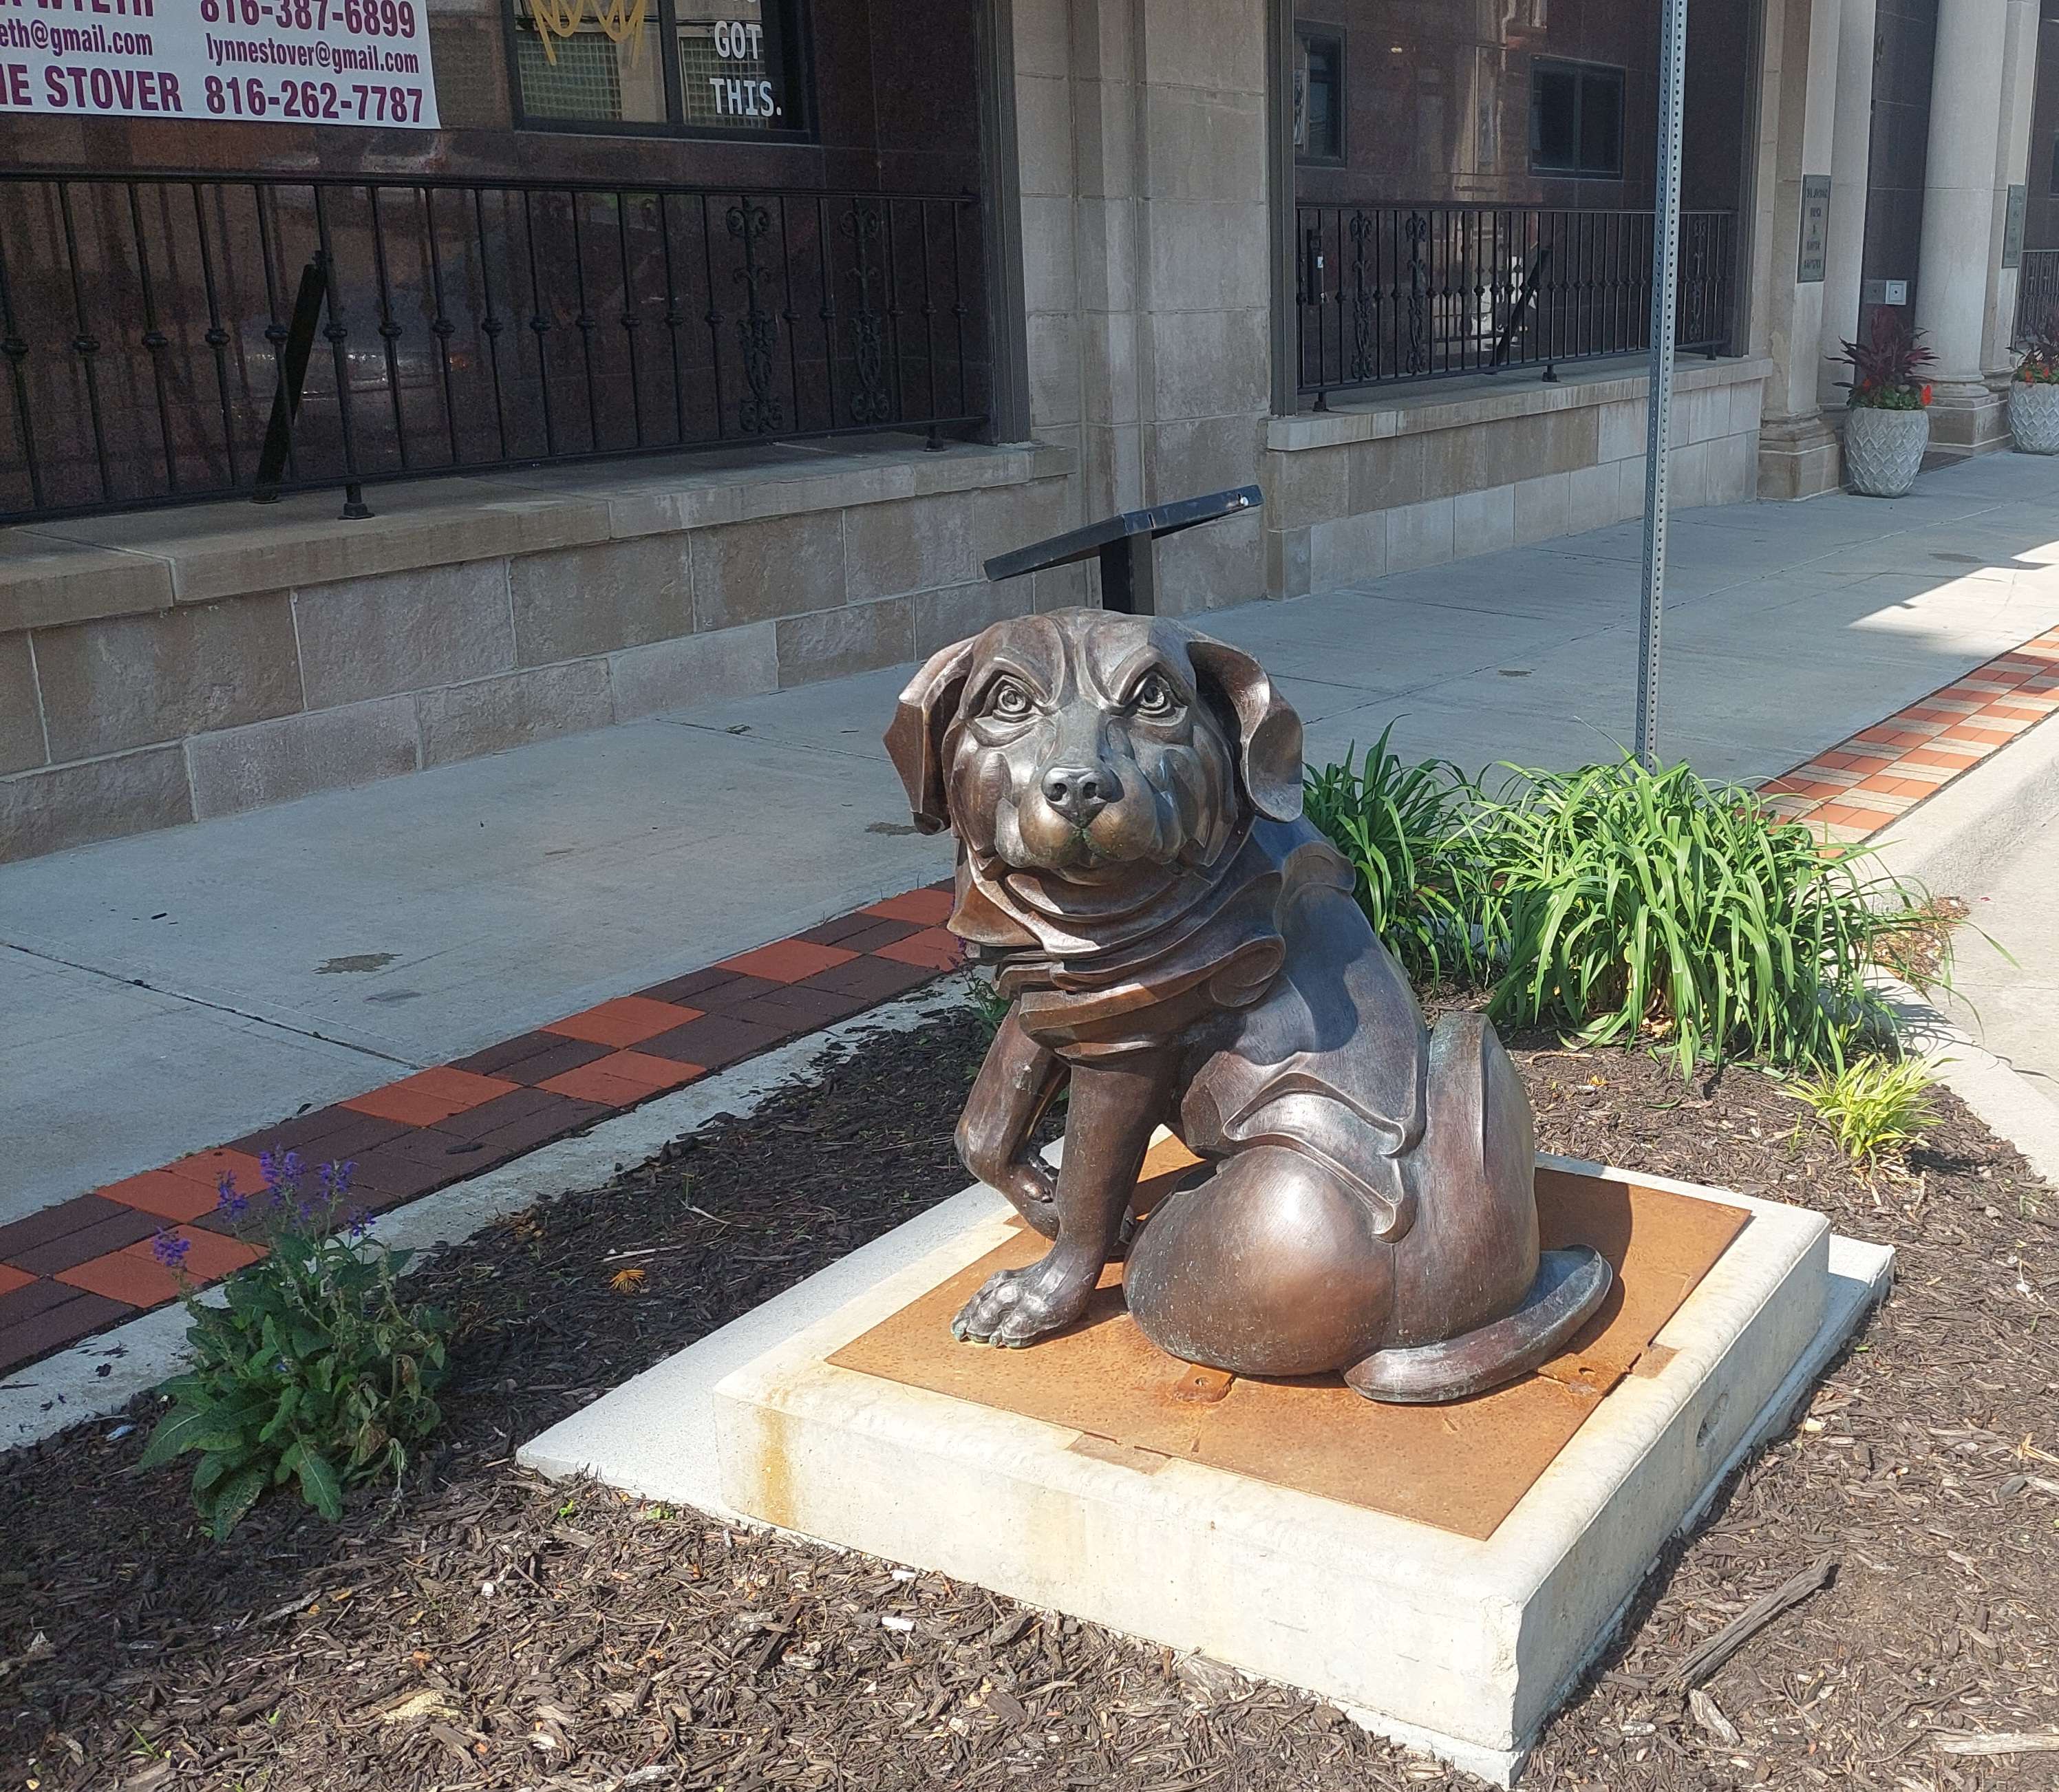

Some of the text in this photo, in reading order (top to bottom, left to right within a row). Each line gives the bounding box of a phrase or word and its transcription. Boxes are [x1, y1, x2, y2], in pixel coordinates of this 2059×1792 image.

[206, 33, 419, 74] lynnestover@gmail.com
[714, 21, 760, 59] GOT
[44, 65, 183, 111] STOVER
[204, 75, 422, 122] 816-262-7787
[709, 78, 782, 117] THIS.
